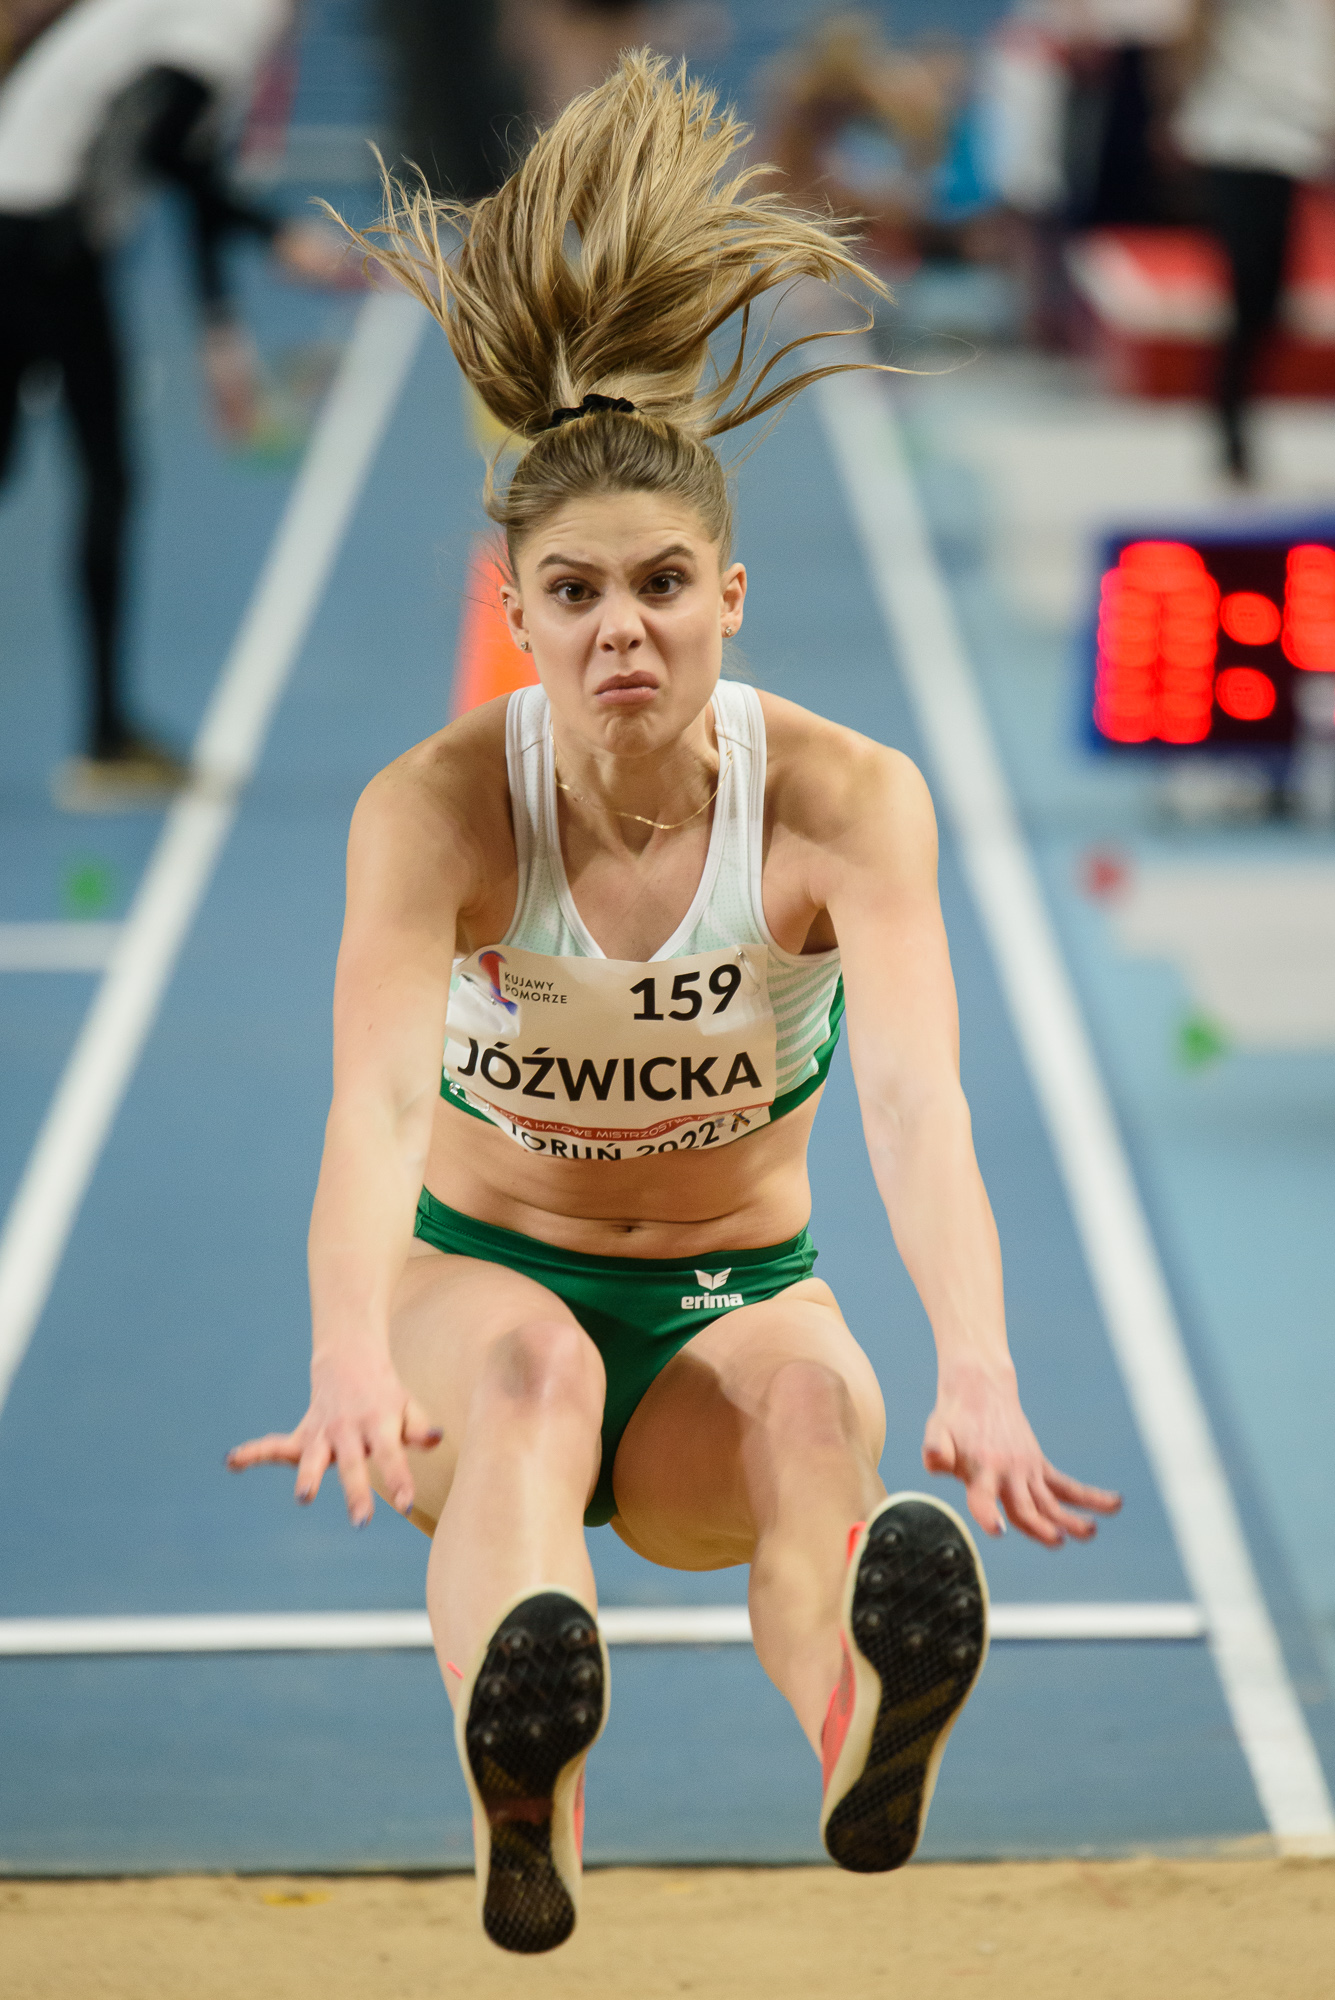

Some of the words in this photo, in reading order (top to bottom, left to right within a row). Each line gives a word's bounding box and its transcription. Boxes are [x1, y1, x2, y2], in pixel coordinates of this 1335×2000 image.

[504, 971, 554, 992] KUJAWY
[629, 963, 742, 1022] 159
[505, 983, 568, 1005] POMORZE
[457, 1036, 762, 1102] JÓŹWICKA
[535, 1122, 592, 1138] HALOWE
[596, 1115, 694, 1139] MISTRZOSTWA
[681, 1292, 744, 1310] erima
